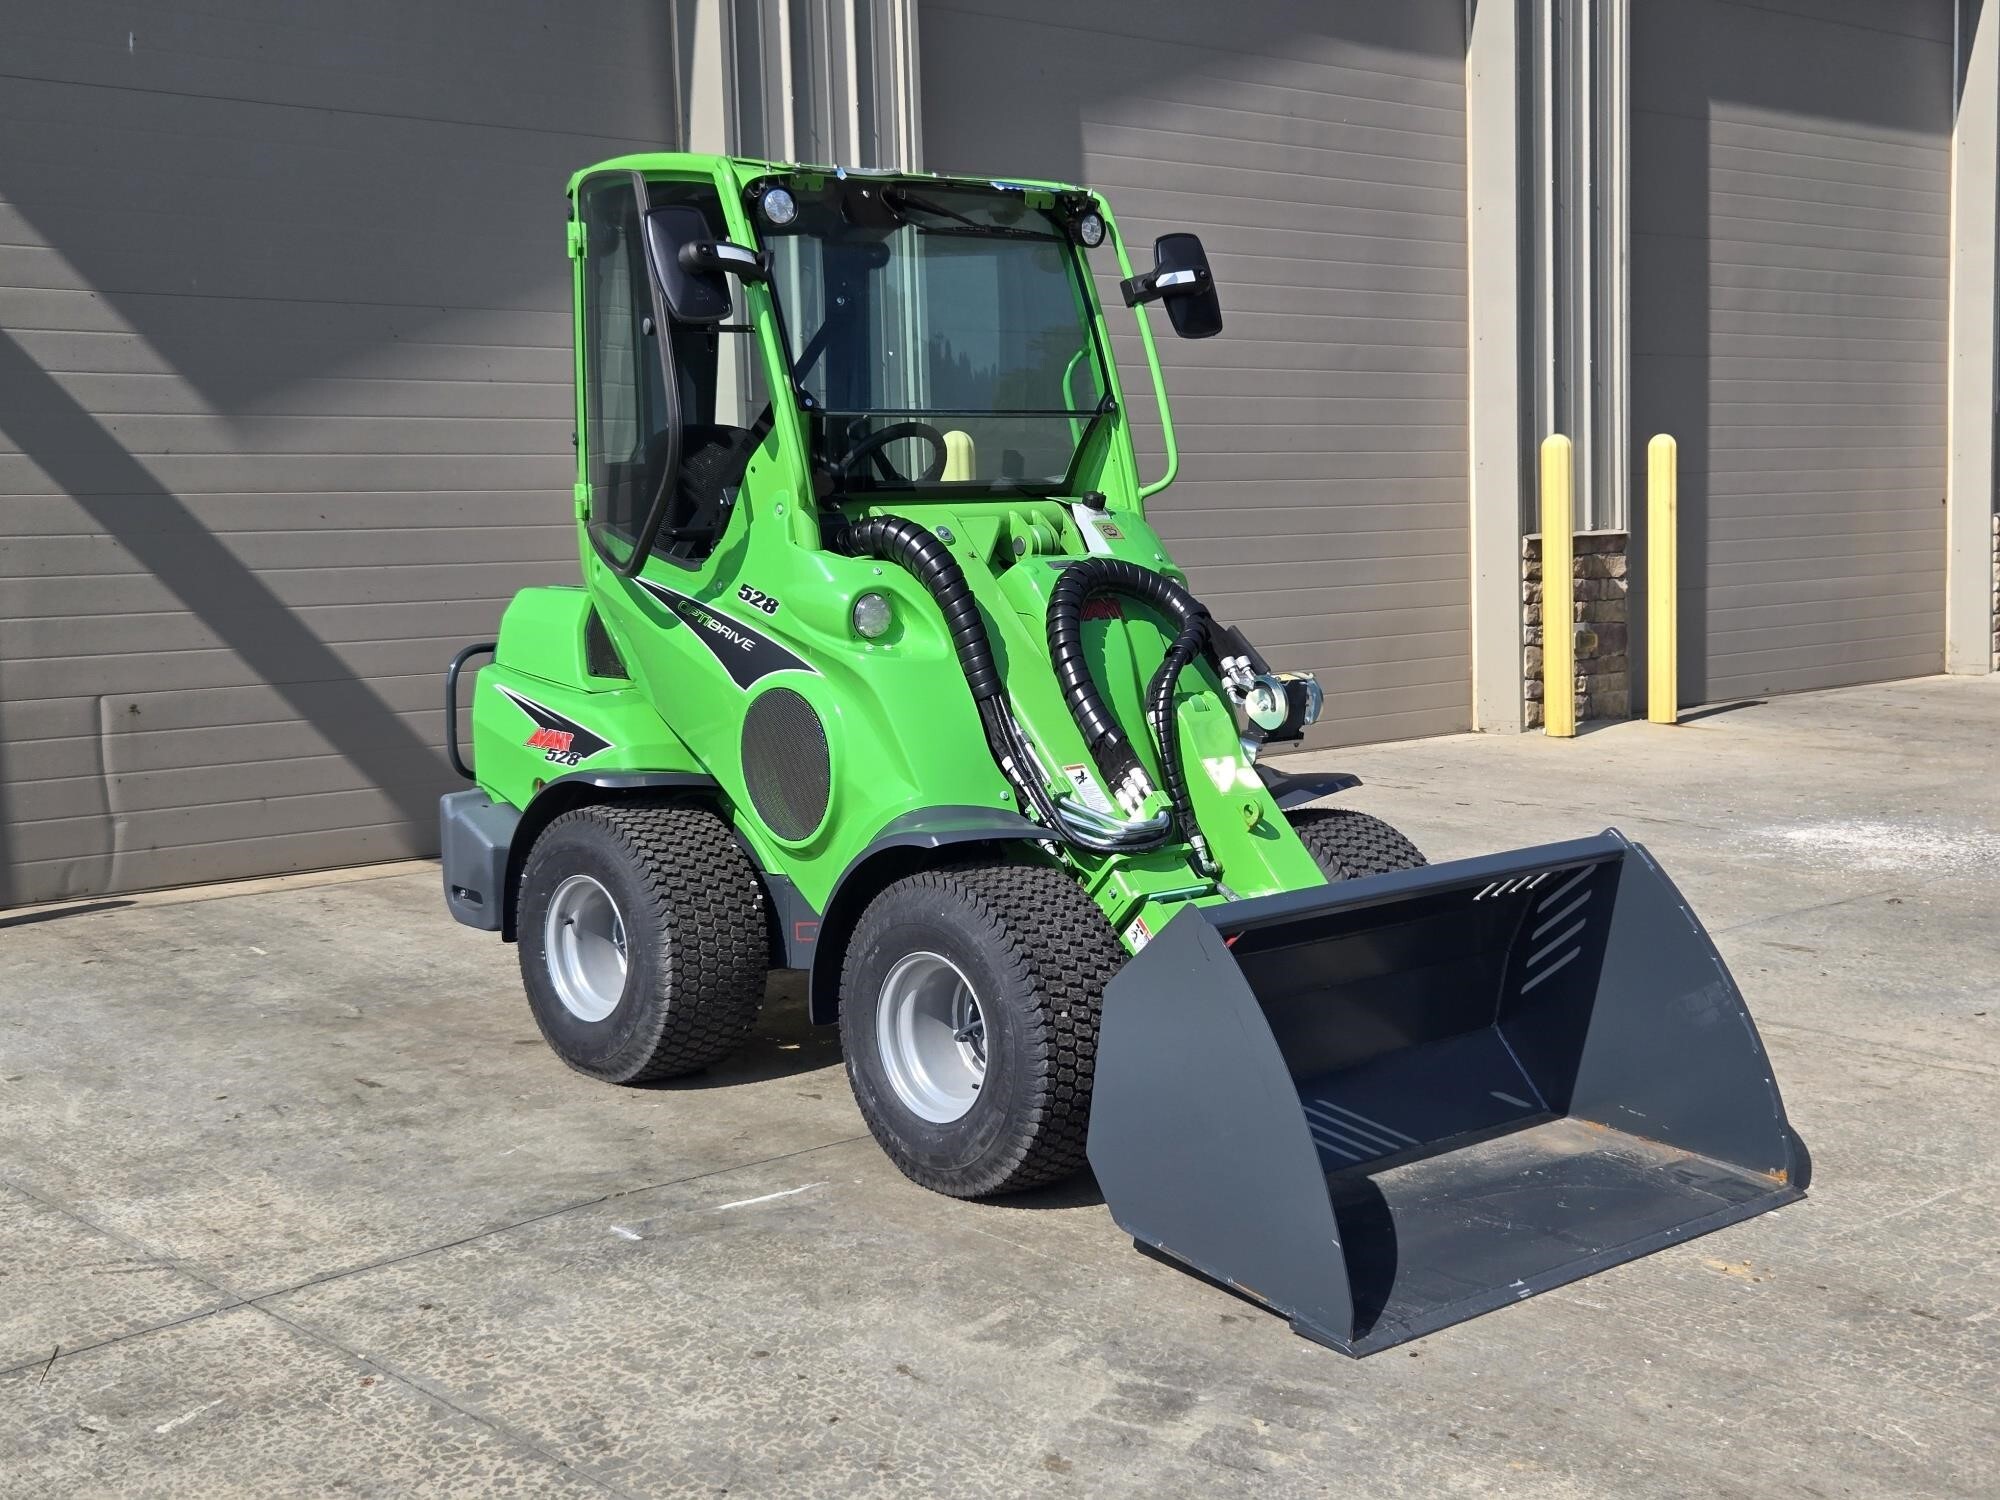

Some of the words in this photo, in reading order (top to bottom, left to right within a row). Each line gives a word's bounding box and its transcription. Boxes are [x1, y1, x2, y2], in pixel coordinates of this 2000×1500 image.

[737, 583, 780, 615] 528
[525, 727, 575, 751] AVANT
[544, 748, 582, 766] 528
